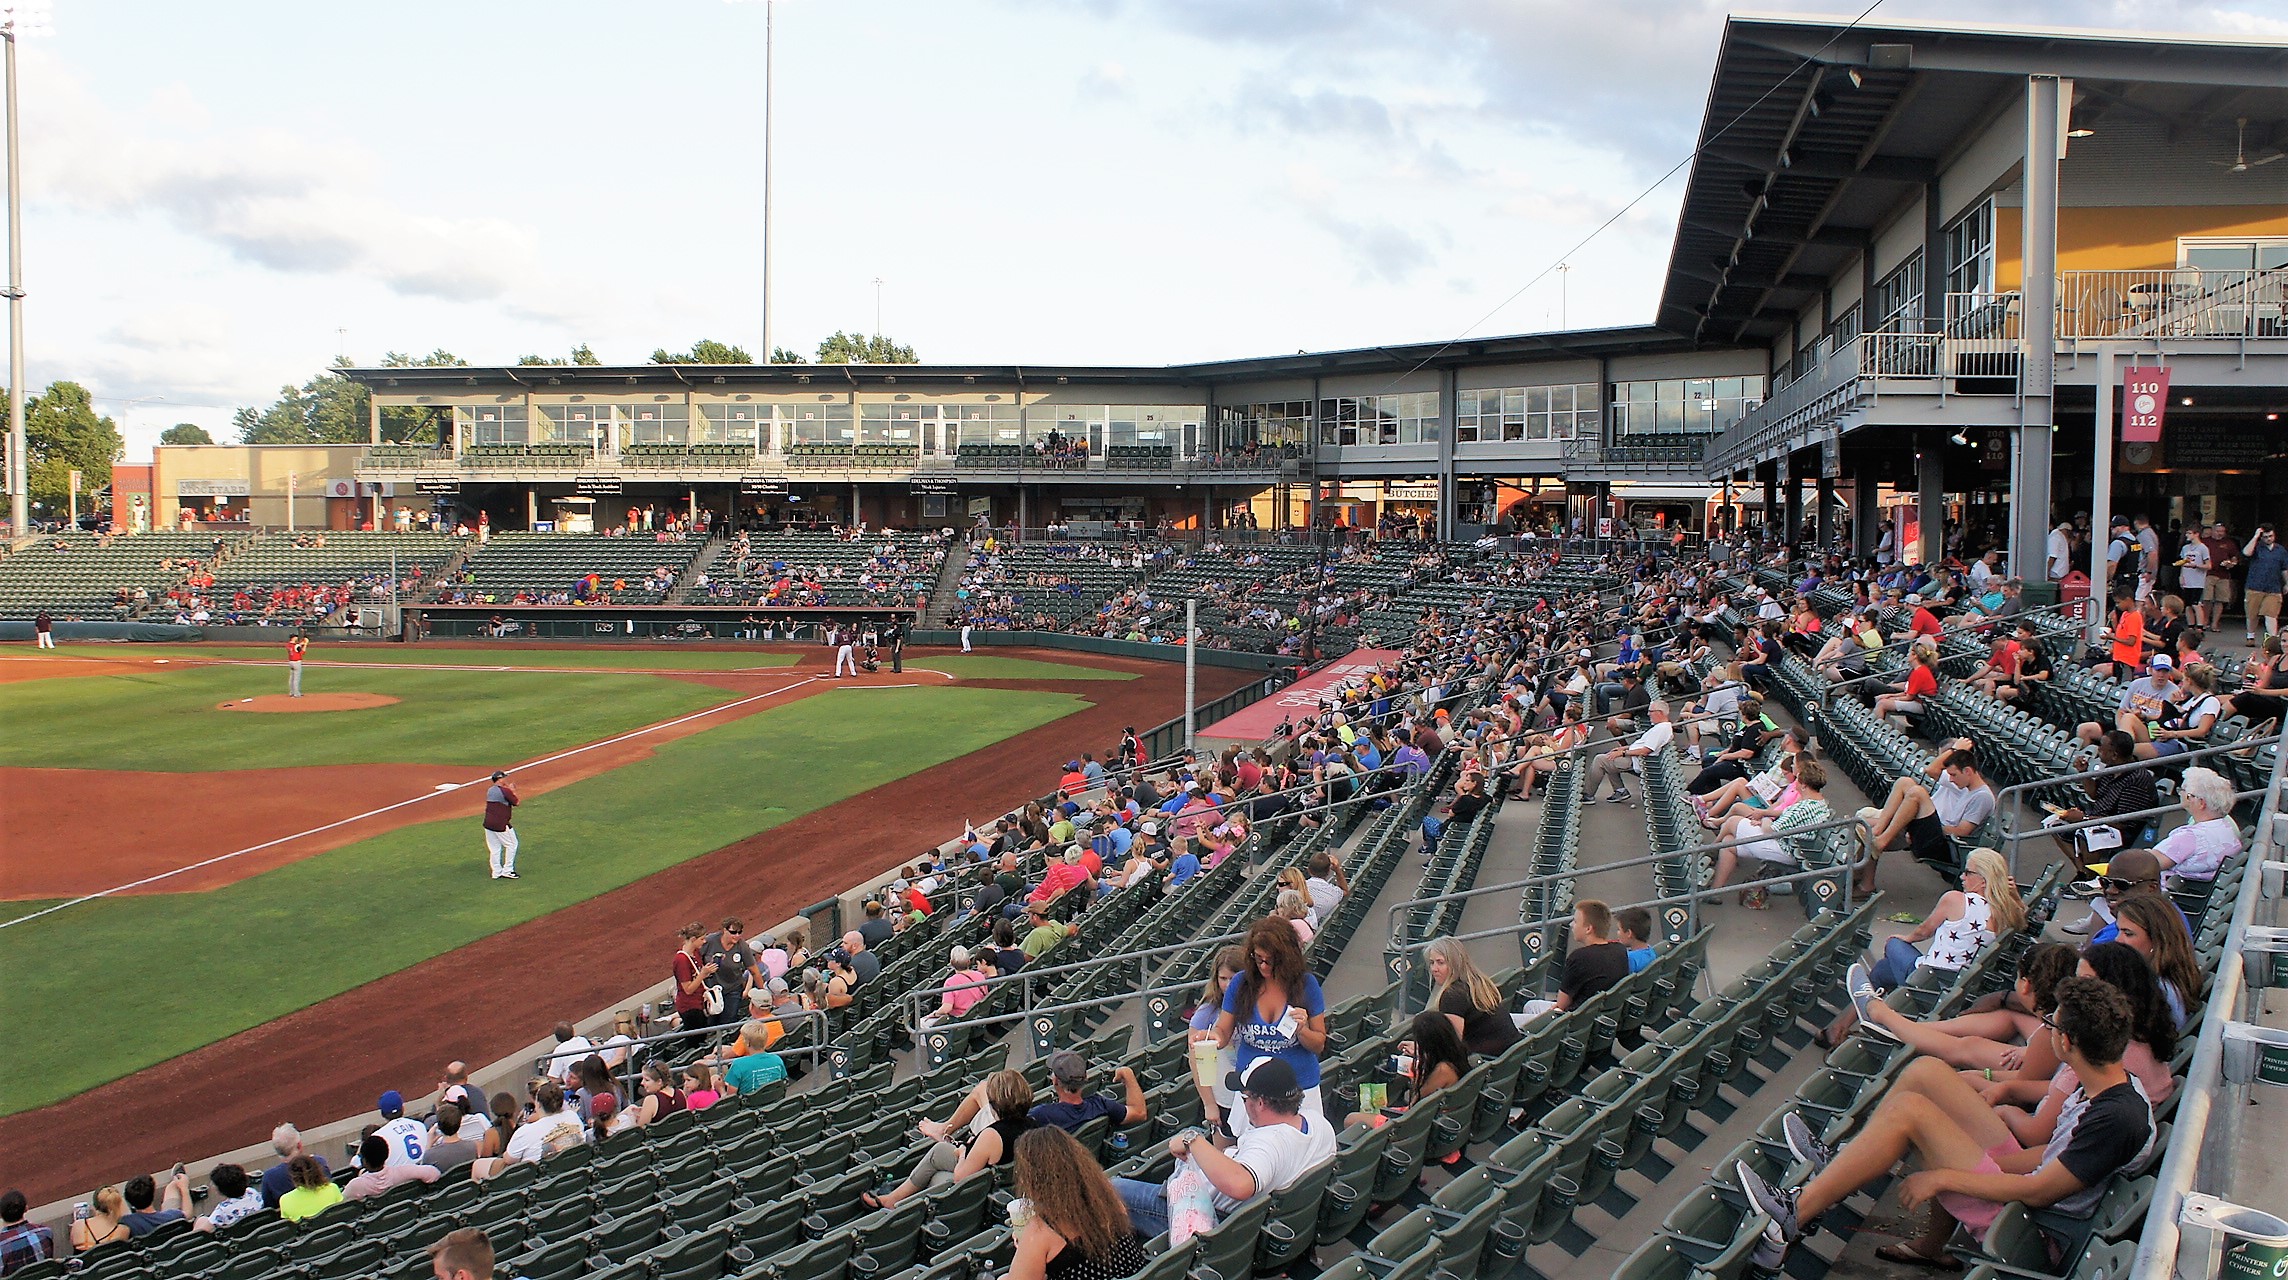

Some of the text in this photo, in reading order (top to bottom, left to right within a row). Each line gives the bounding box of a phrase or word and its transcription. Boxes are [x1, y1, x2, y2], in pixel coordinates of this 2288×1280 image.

[2131, 382, 2159, 394] 110
[2130, 415, 2157, 426] 112
[2262, 1063, 2286, 1072] COPIERS
[393, 1123, 416, 1135] CAIN
[403, 1134, 423, 1160] 6
[2231, 1252, 2269, 1268] PRINTERS
[2228, 1260, 2262, 1276] COPIERS
